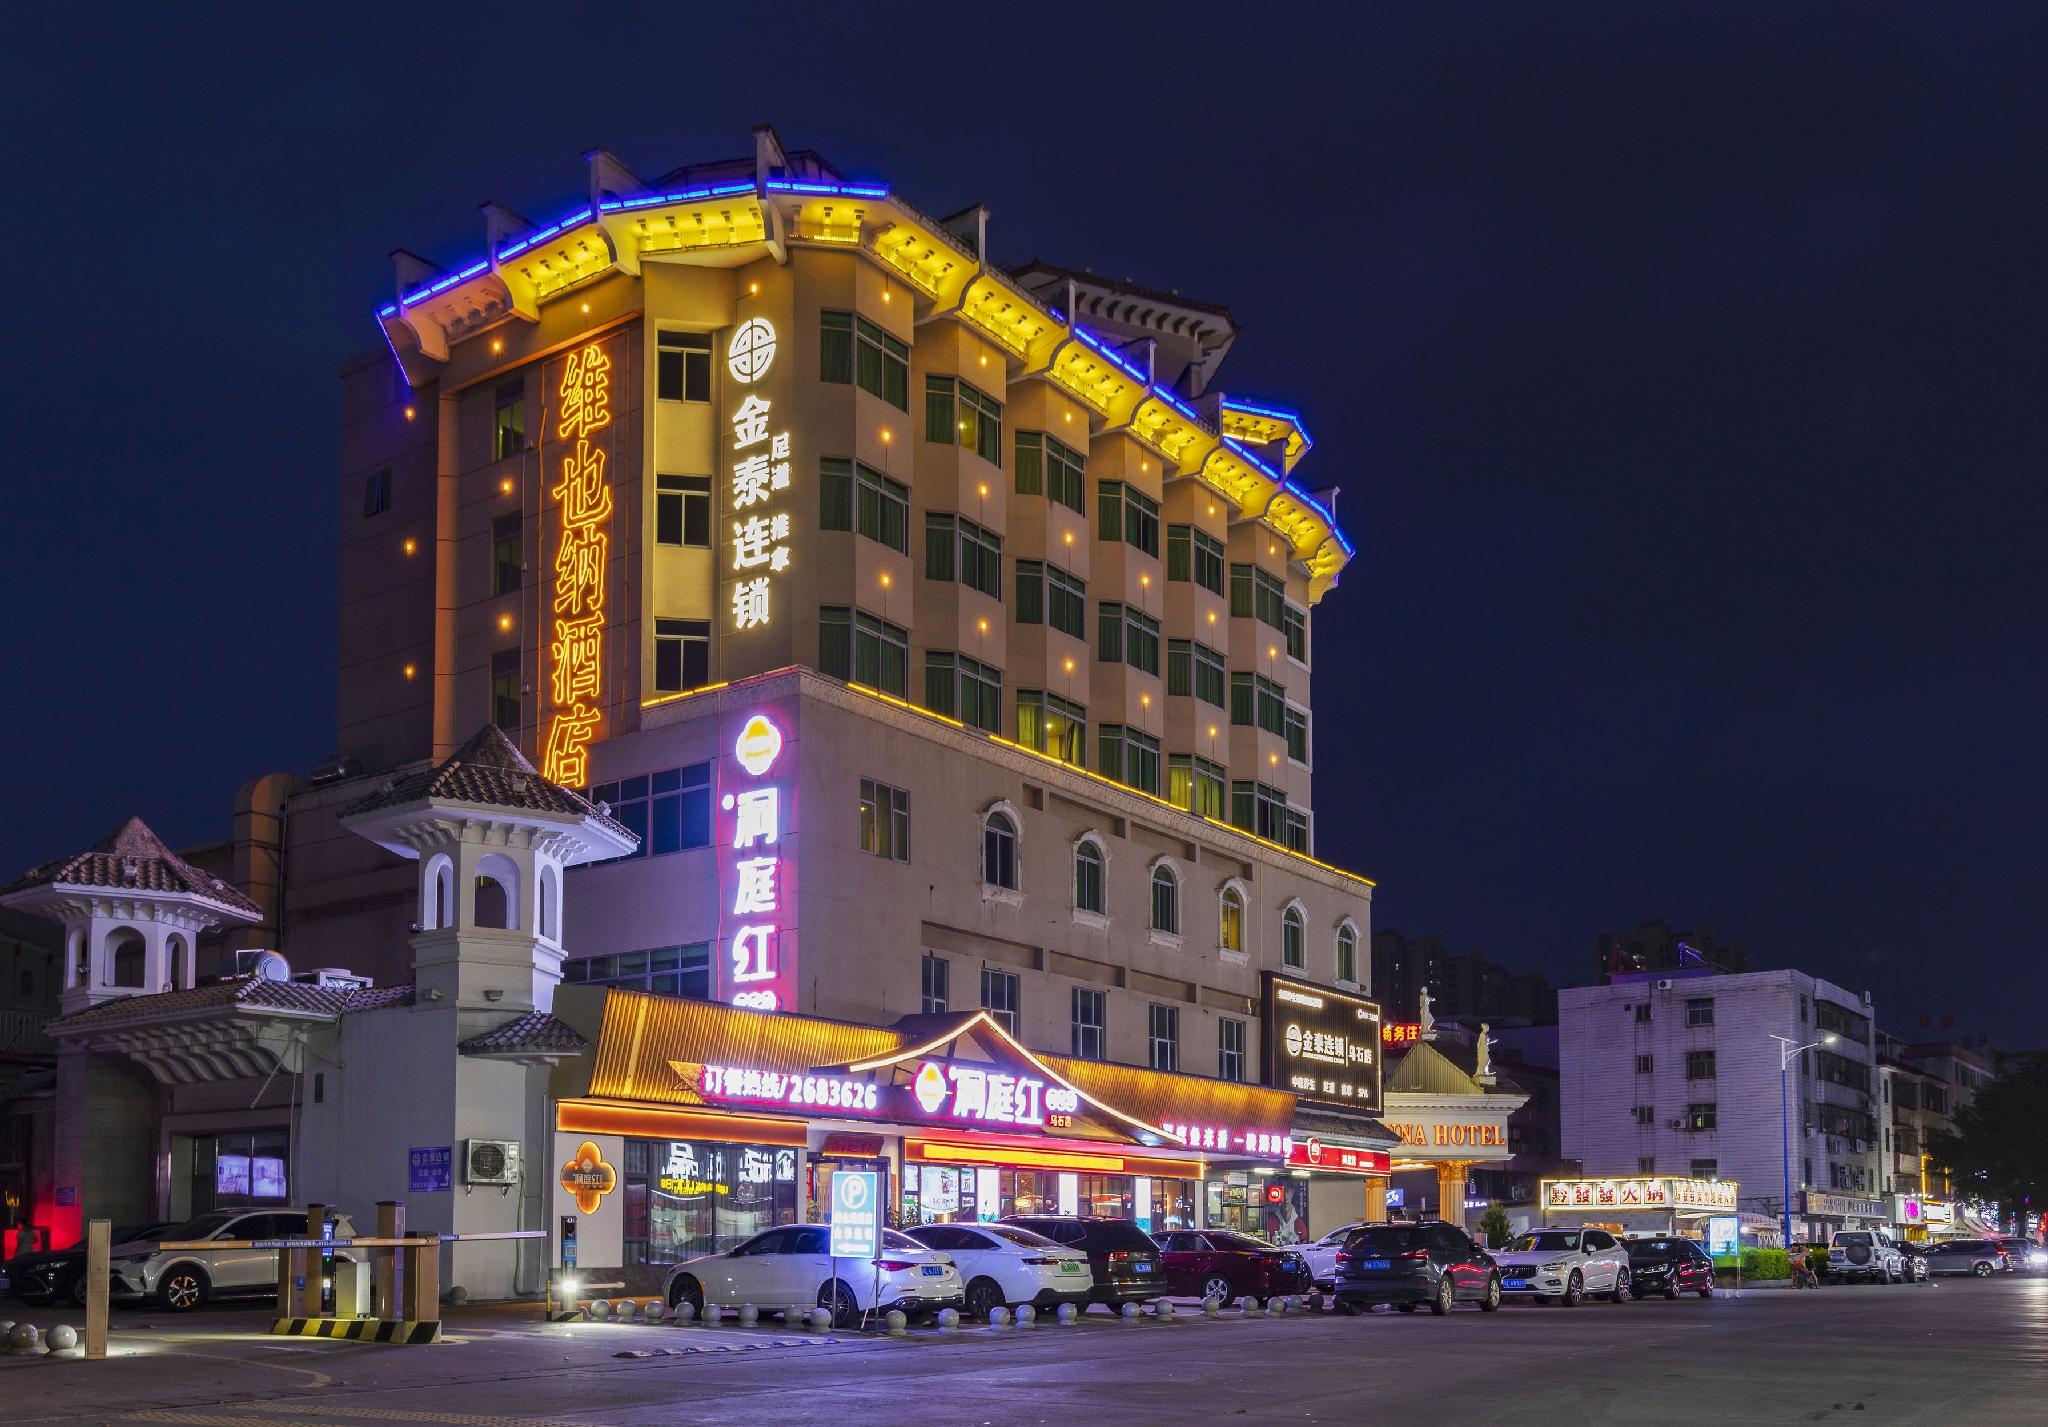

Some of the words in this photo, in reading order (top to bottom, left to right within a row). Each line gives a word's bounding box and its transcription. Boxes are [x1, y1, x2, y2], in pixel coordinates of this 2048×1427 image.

[732, 395, 771, 629] 金泰连锁
[543, 344, 612, 788] 维也纳酒店
[723, 787, 778, 983] 洞庭红
[1302, 1030, 1345, 1058] 金泰连锁
[1383, 1025, 1421, 1042] 商务住
[949, 1067, 1043, 1126] 洞庭红
[1384, 1123, 1427, 1145] NA
[1434, 1123, 1506, 1147] HOTEL
[572, 1173, 603, 1185] 洞庭红
